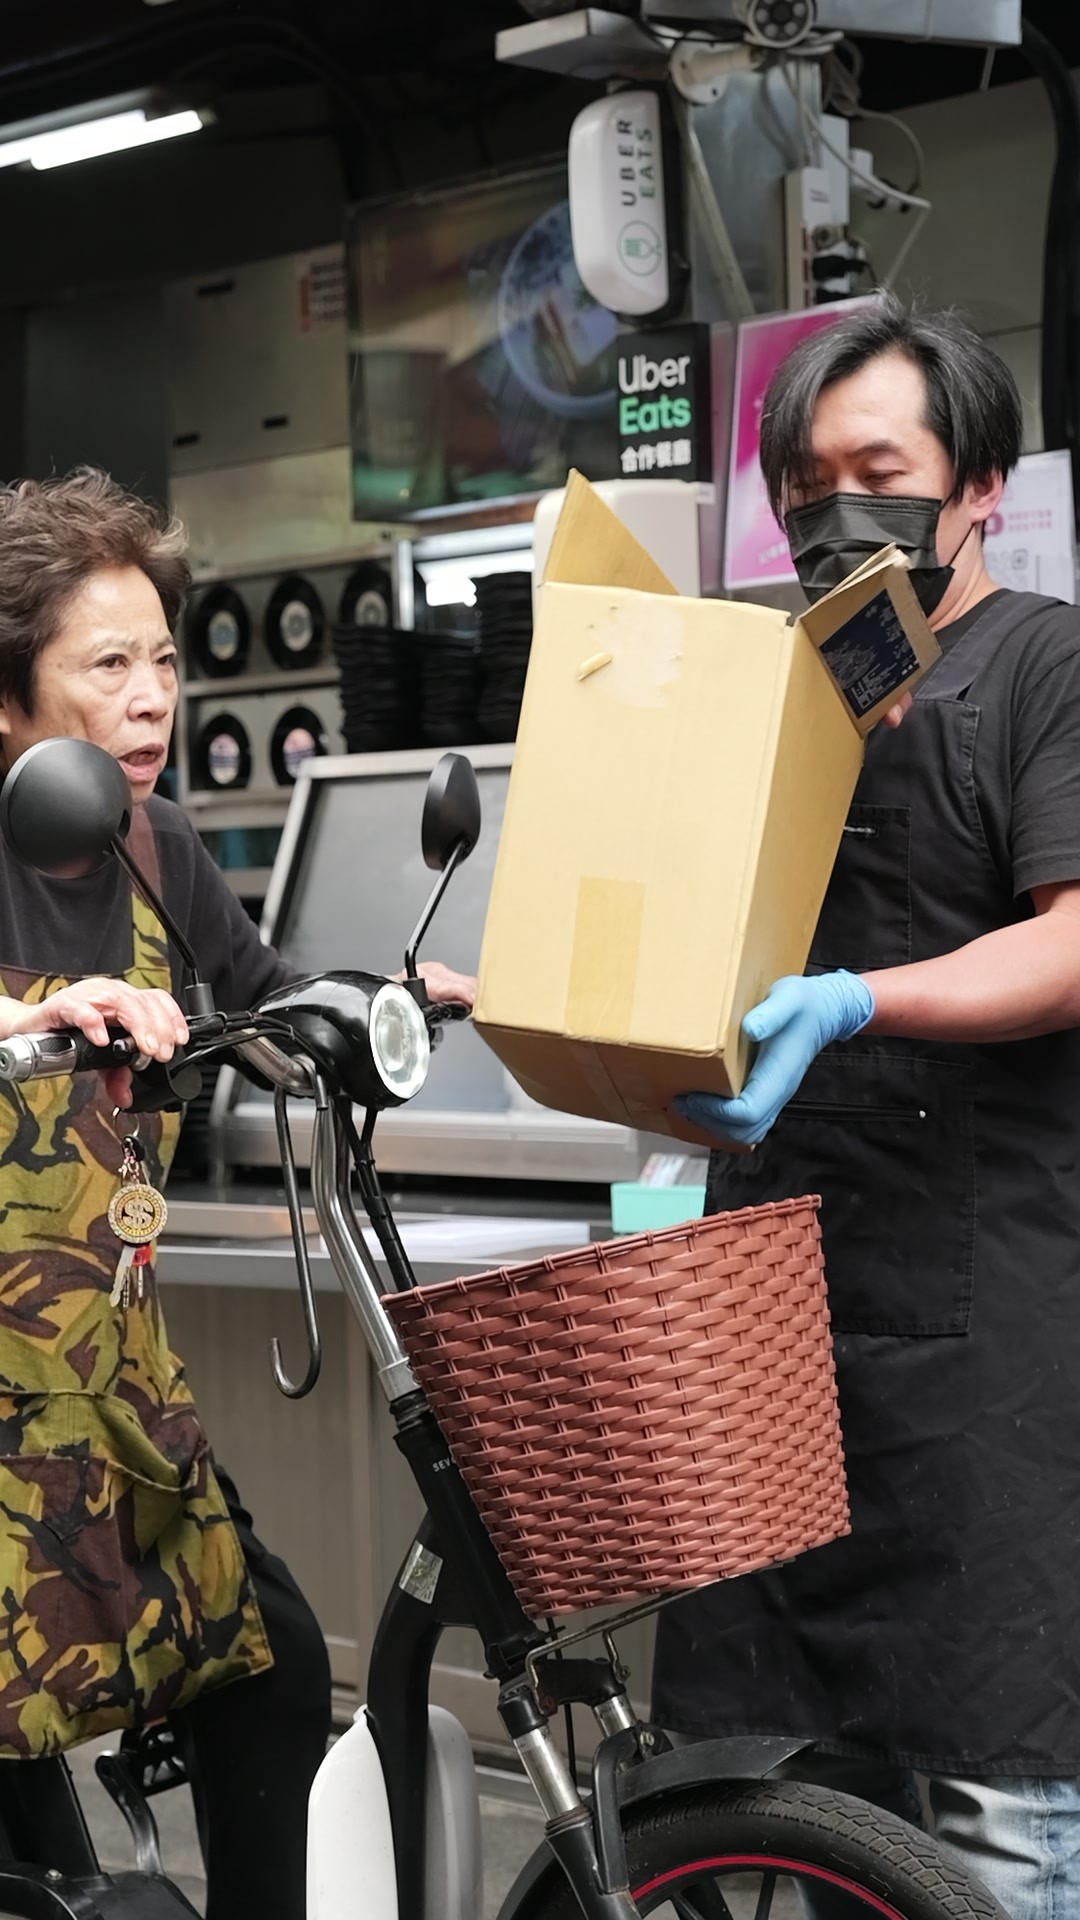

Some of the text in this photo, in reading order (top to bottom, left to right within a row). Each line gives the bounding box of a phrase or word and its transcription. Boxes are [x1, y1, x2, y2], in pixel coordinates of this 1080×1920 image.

[618, 120, 637, 206] UBER
[637, 128, 655, 198] EATS
[619, 354, 691, 394] Uber
[620, 394, 691, 435] Eats
